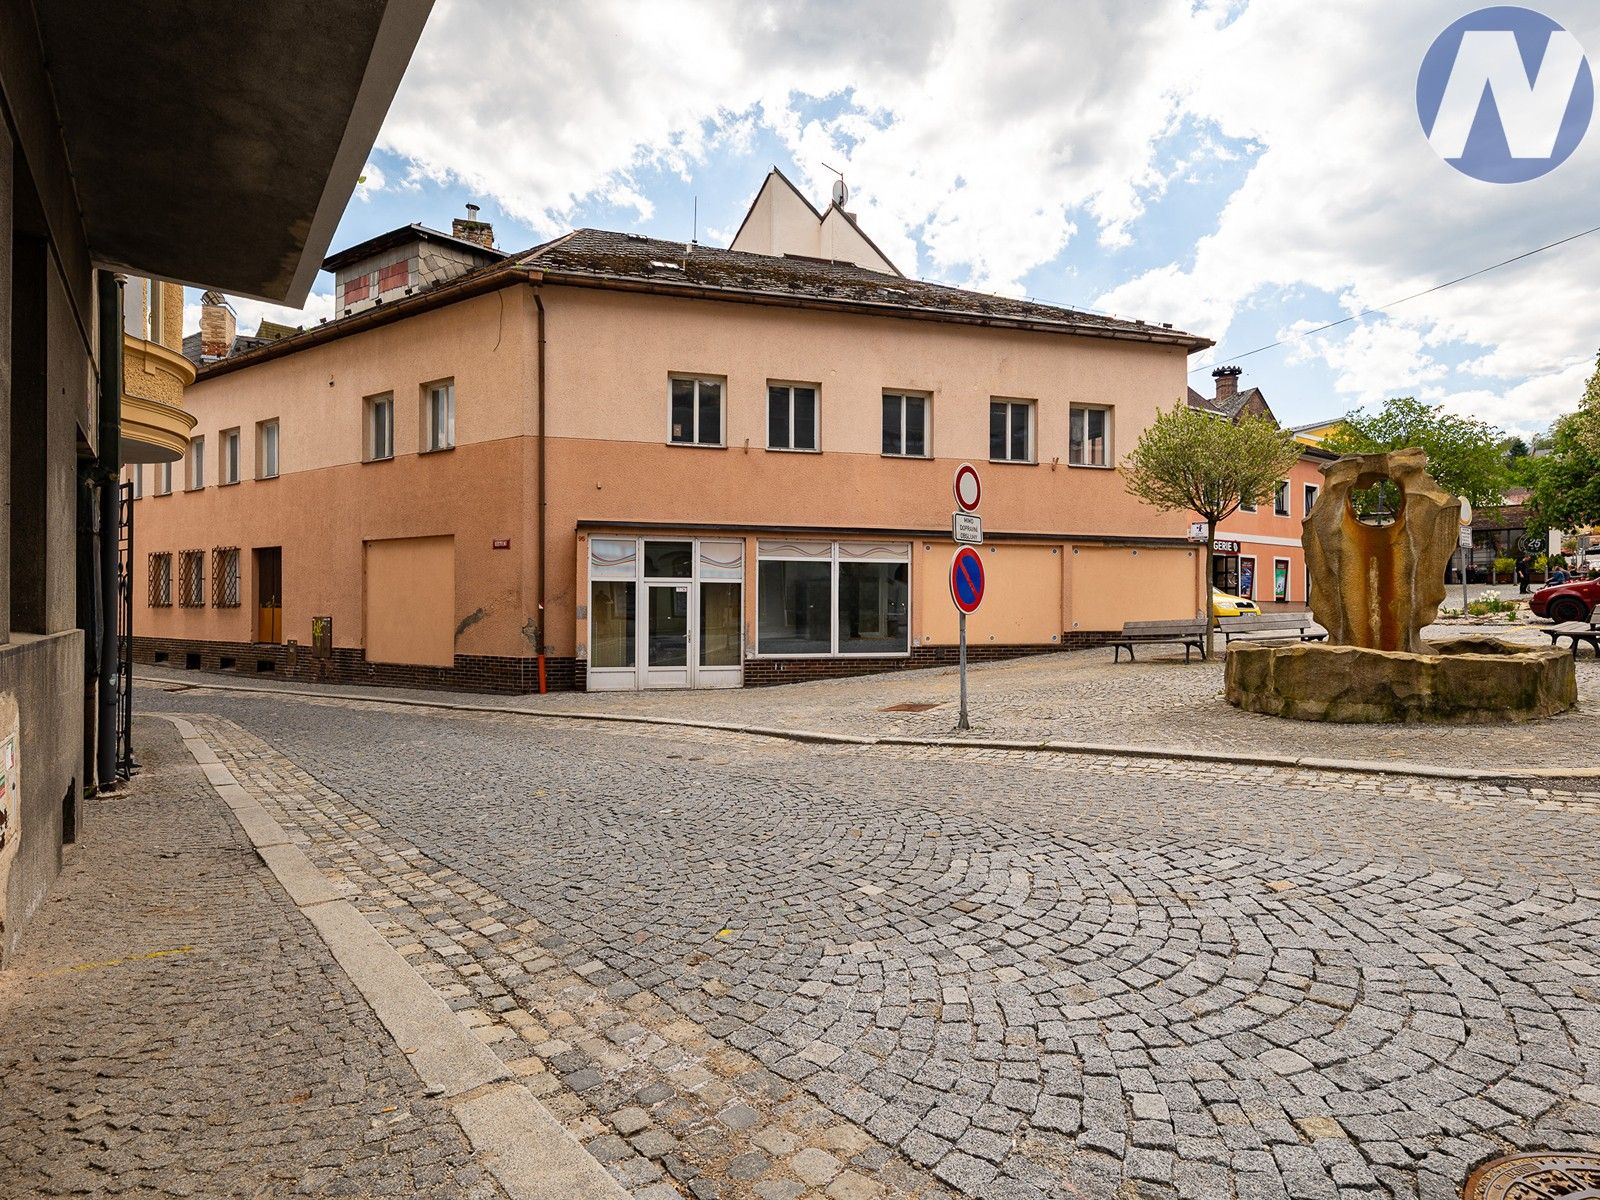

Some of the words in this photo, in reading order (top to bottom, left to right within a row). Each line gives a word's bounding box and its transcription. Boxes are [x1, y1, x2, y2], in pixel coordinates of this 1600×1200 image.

[963, 517, 974, 525] MIMO
[1213, 540, 1232, 551] GERIE
[1527, 538, 1542, 548] 25
